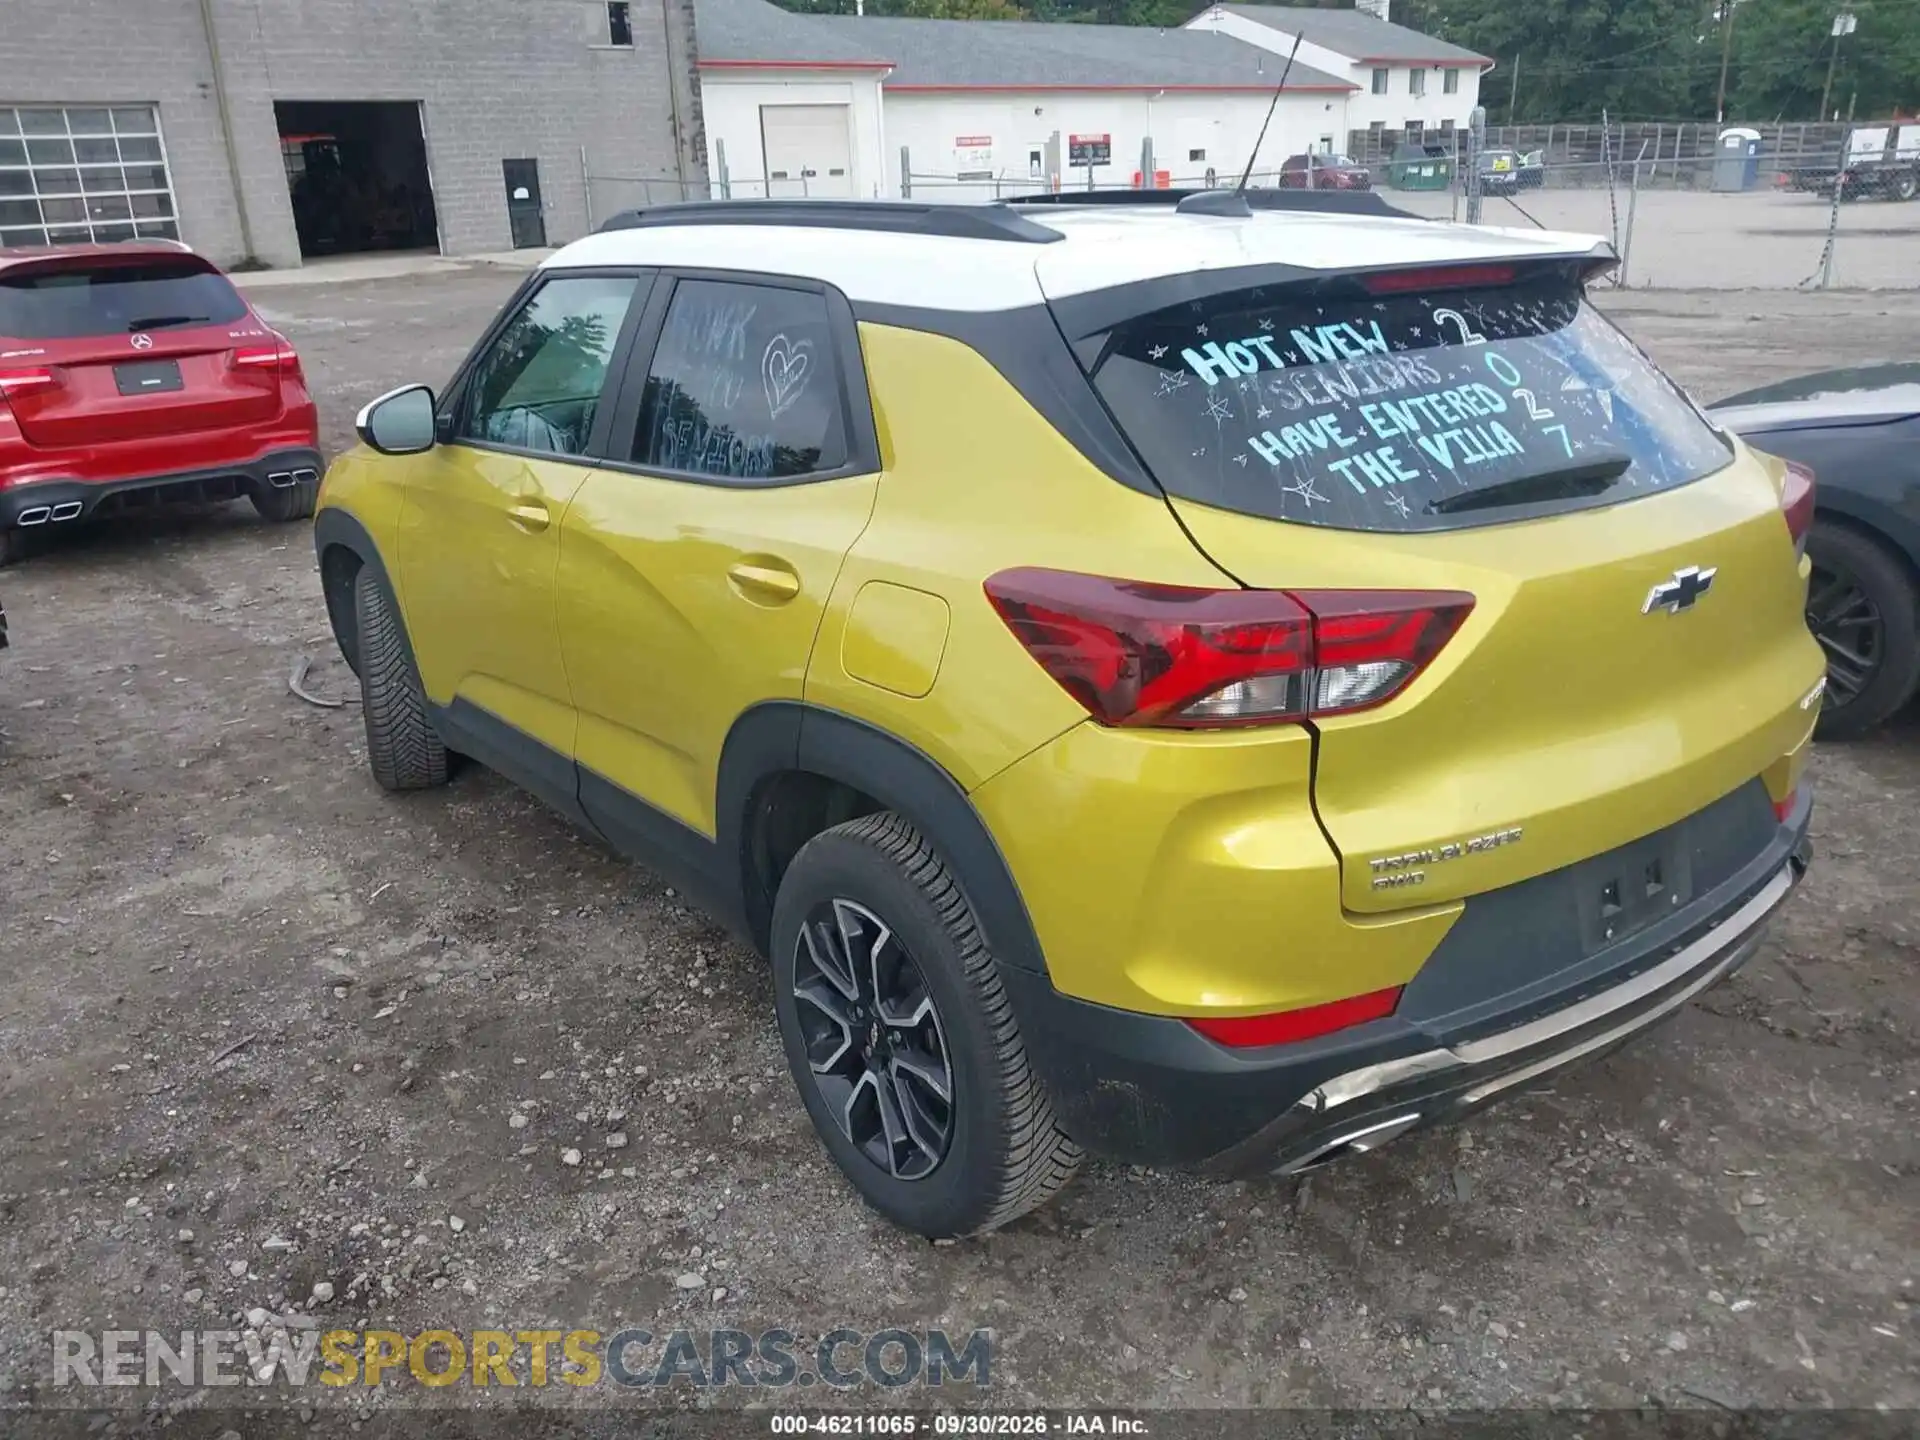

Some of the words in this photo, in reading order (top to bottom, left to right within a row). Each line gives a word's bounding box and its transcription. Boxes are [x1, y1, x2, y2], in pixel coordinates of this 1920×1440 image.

[1181, 335, 1285, 386] HOT
[1290, 319, 1389, 364] NEW
[1269, 355, 1441, 410] SENIORS
[1248, 413, 1357, 466] HAVE
[1358, 382, 1507, 439] ENTERED
[1328, 446, 1420, 494] THE
[1417, 420, 1525, 470] VILLA
